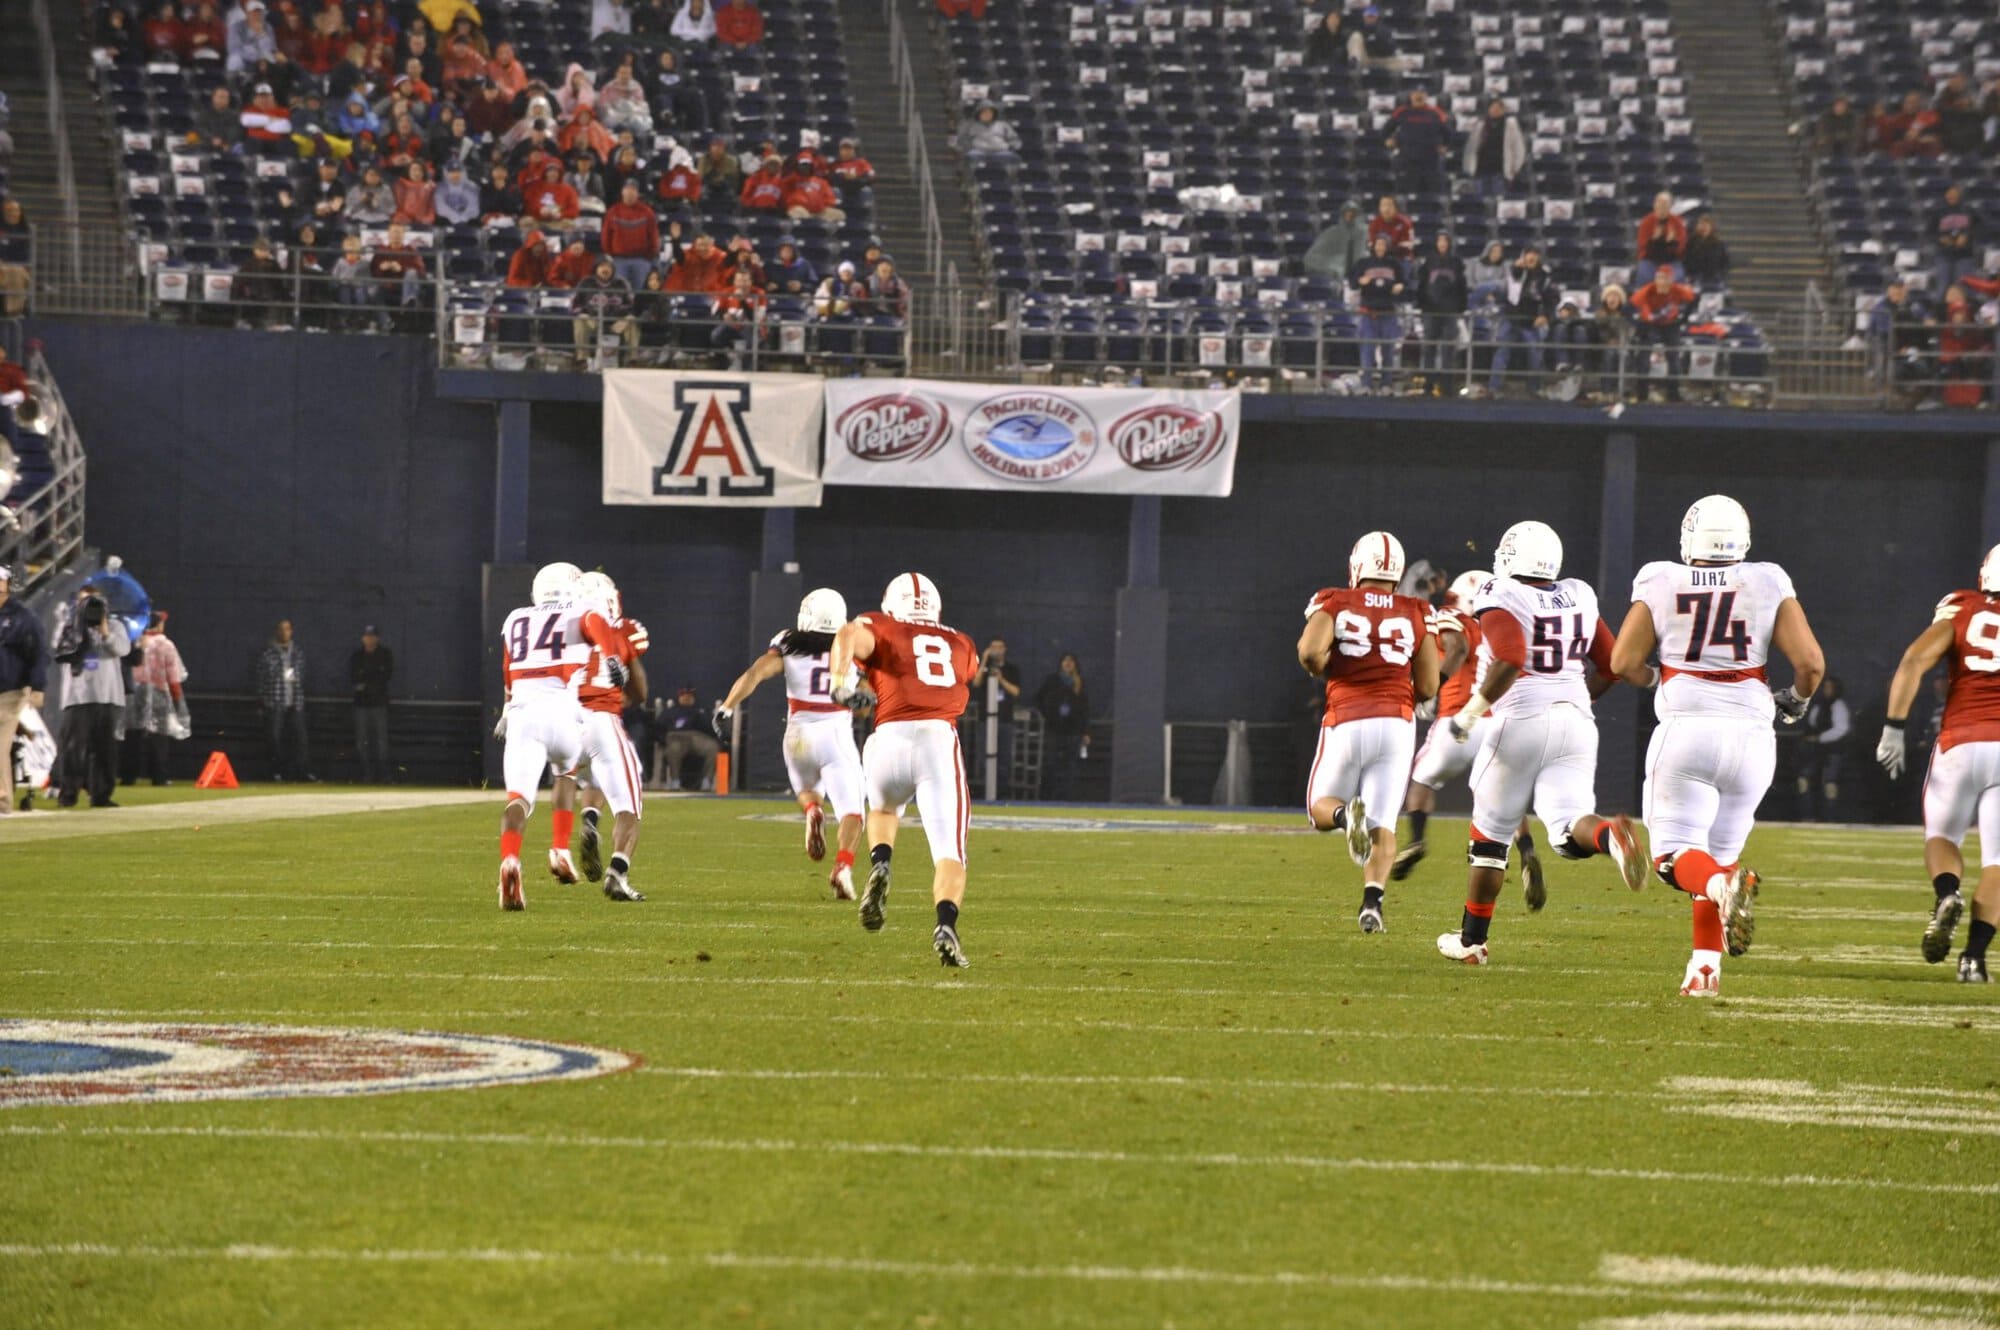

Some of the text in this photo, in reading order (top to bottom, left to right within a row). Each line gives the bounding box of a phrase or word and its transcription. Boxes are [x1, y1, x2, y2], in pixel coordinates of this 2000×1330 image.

[856, 410, 931, 453] Pepper
[880, 404, 911, 427] Dr
[982, 398, 1080, 424] PACIFIC LIFE
[1153, 414, 1185, 440] Dr
[653, 380, 774, 496] A
[1129, 419, 1205, 463] Pepper
[973, 443, 1087, 478] HOLIDAY BOWL
[1691, 570, 1728, 586] DIAZ
[1363, 592, 1394, 609] SUH
[511, 613, 566, 664] 84
[1335, 609, 1416, 666] 93
[1533, 612, 1588, 674] 54
[1676, 591, 1752, 662] 74
[912, 634, 957, 687] 8
